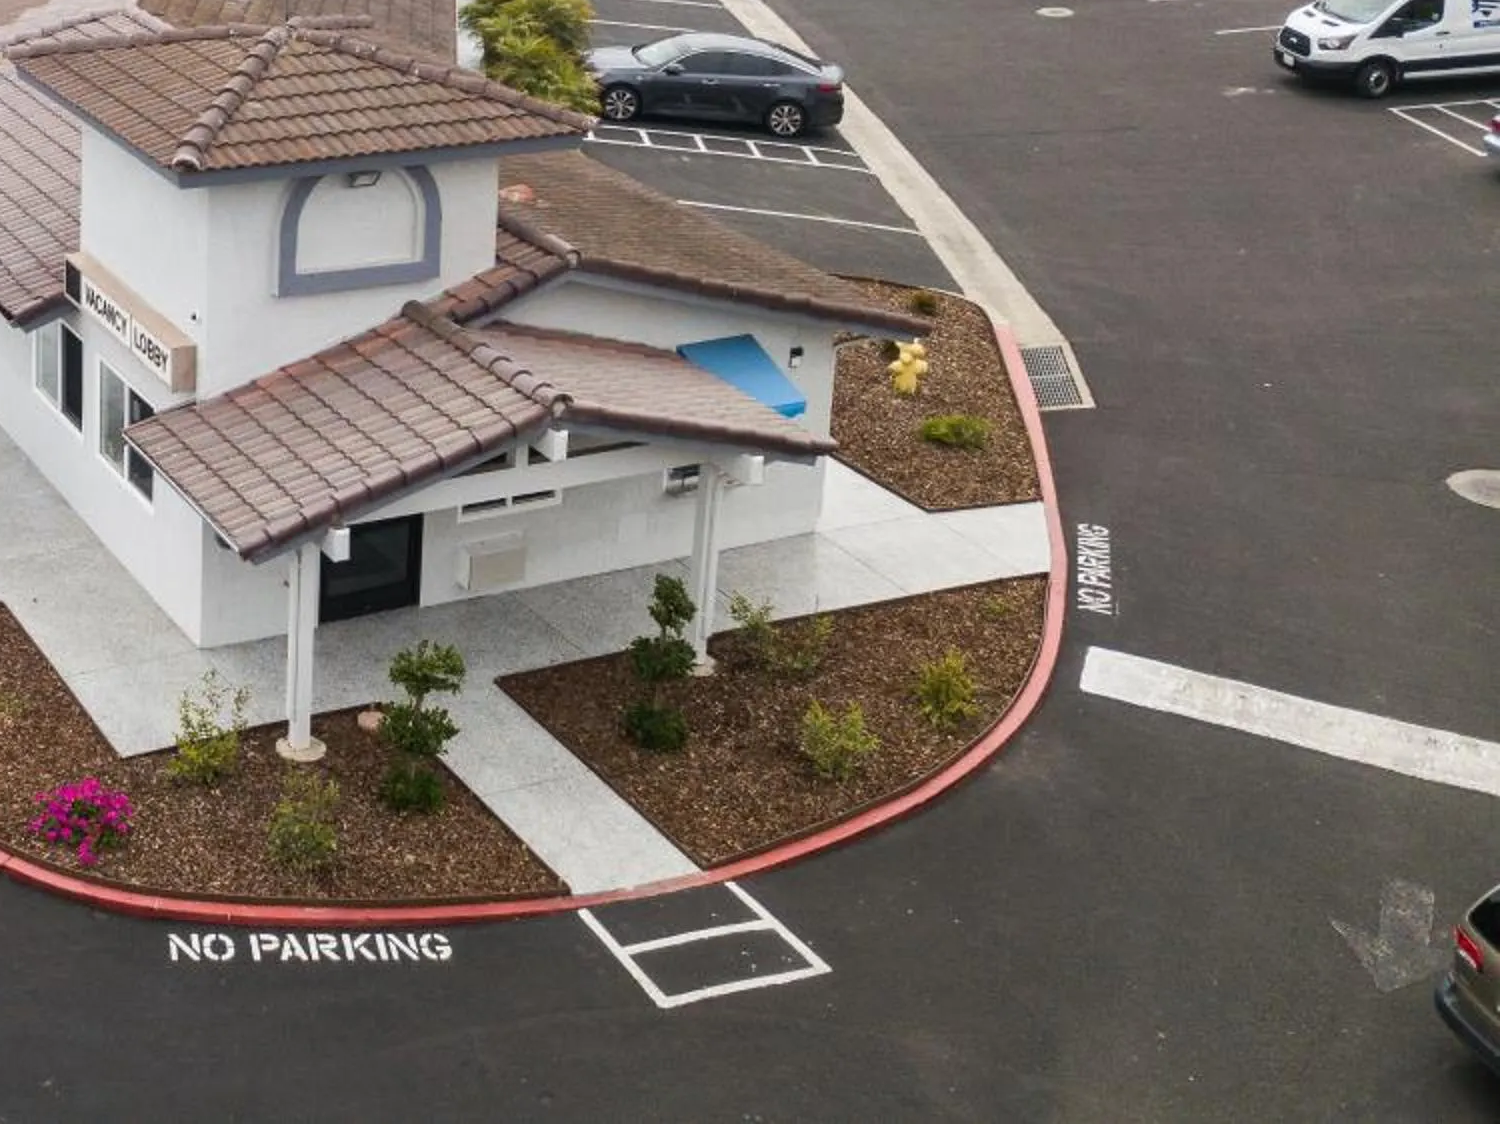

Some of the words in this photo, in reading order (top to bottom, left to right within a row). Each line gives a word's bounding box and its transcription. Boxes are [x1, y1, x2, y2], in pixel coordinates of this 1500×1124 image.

[85, 283, 127, 337] VACANCY
[133, 326, 169, 372] LOBBY
[1076, 523, 1112, 589] PARKING
[1076, 587, 1112, 615] NO
[168, 933, 235, 961] NO
[249, 933, 453, 961] PARKING
